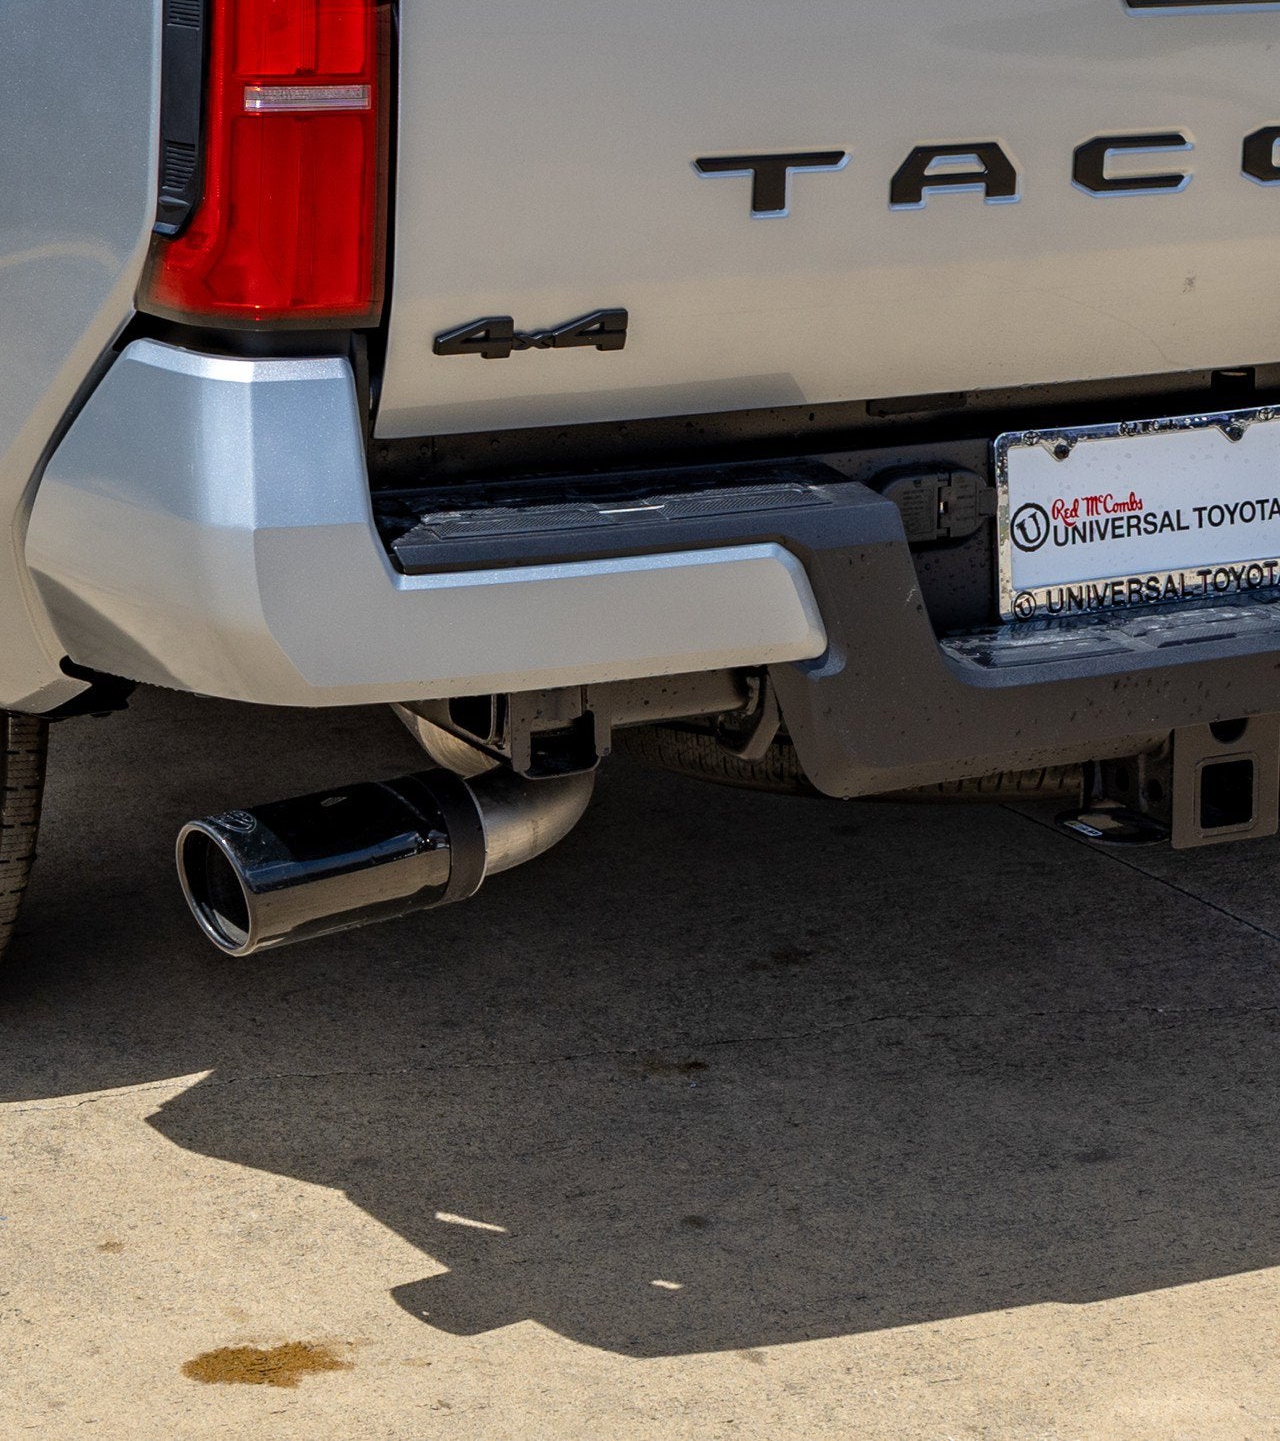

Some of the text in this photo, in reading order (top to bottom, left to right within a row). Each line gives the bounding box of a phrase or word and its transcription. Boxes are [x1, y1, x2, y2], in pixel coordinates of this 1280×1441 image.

[1051, 491, 1144, 527] Red McCombs
[1053, 508, 1190, 547] UNIVERSAL
[1045, 572, 1194, 614] UNIVERSAL
